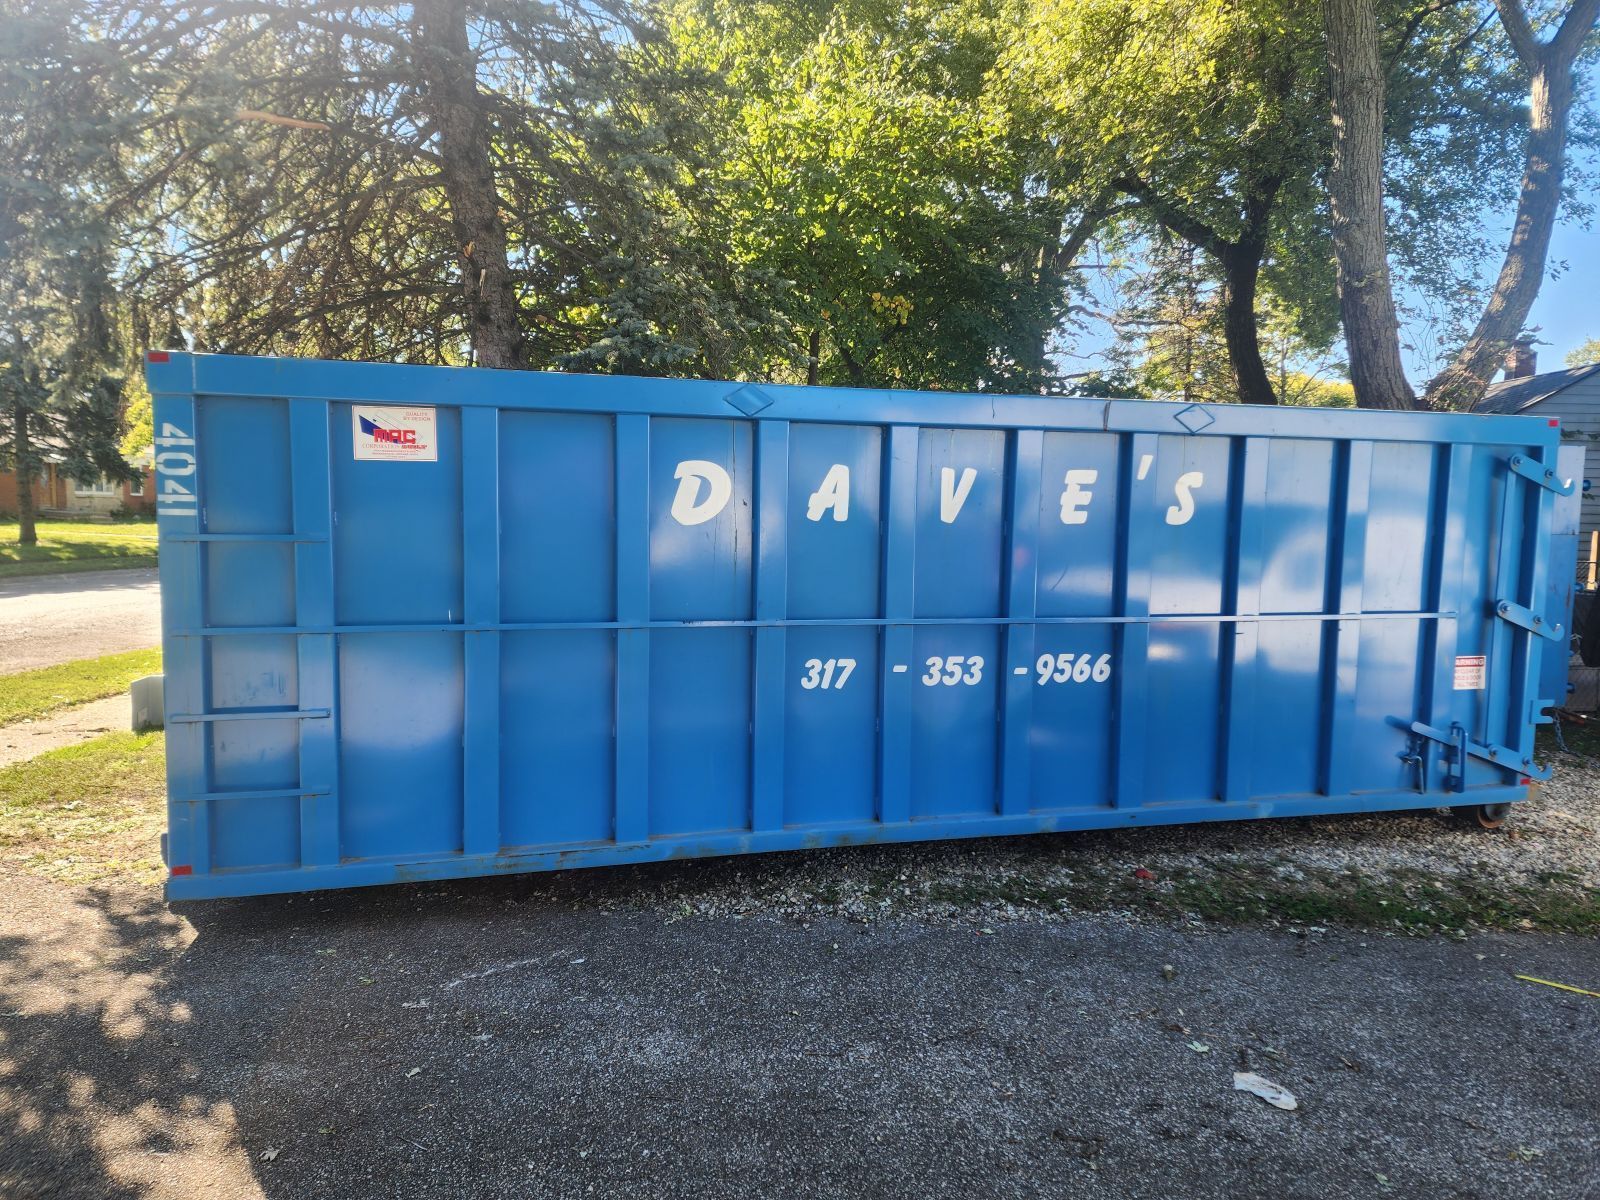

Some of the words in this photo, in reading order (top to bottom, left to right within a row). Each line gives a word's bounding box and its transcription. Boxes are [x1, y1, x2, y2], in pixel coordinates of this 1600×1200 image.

[373, 429, 416, 444] MAC
[155, 422, 197, 516] 4041
[801, 658, 857, 690] 317
[922, 655, 985, 687] 353
